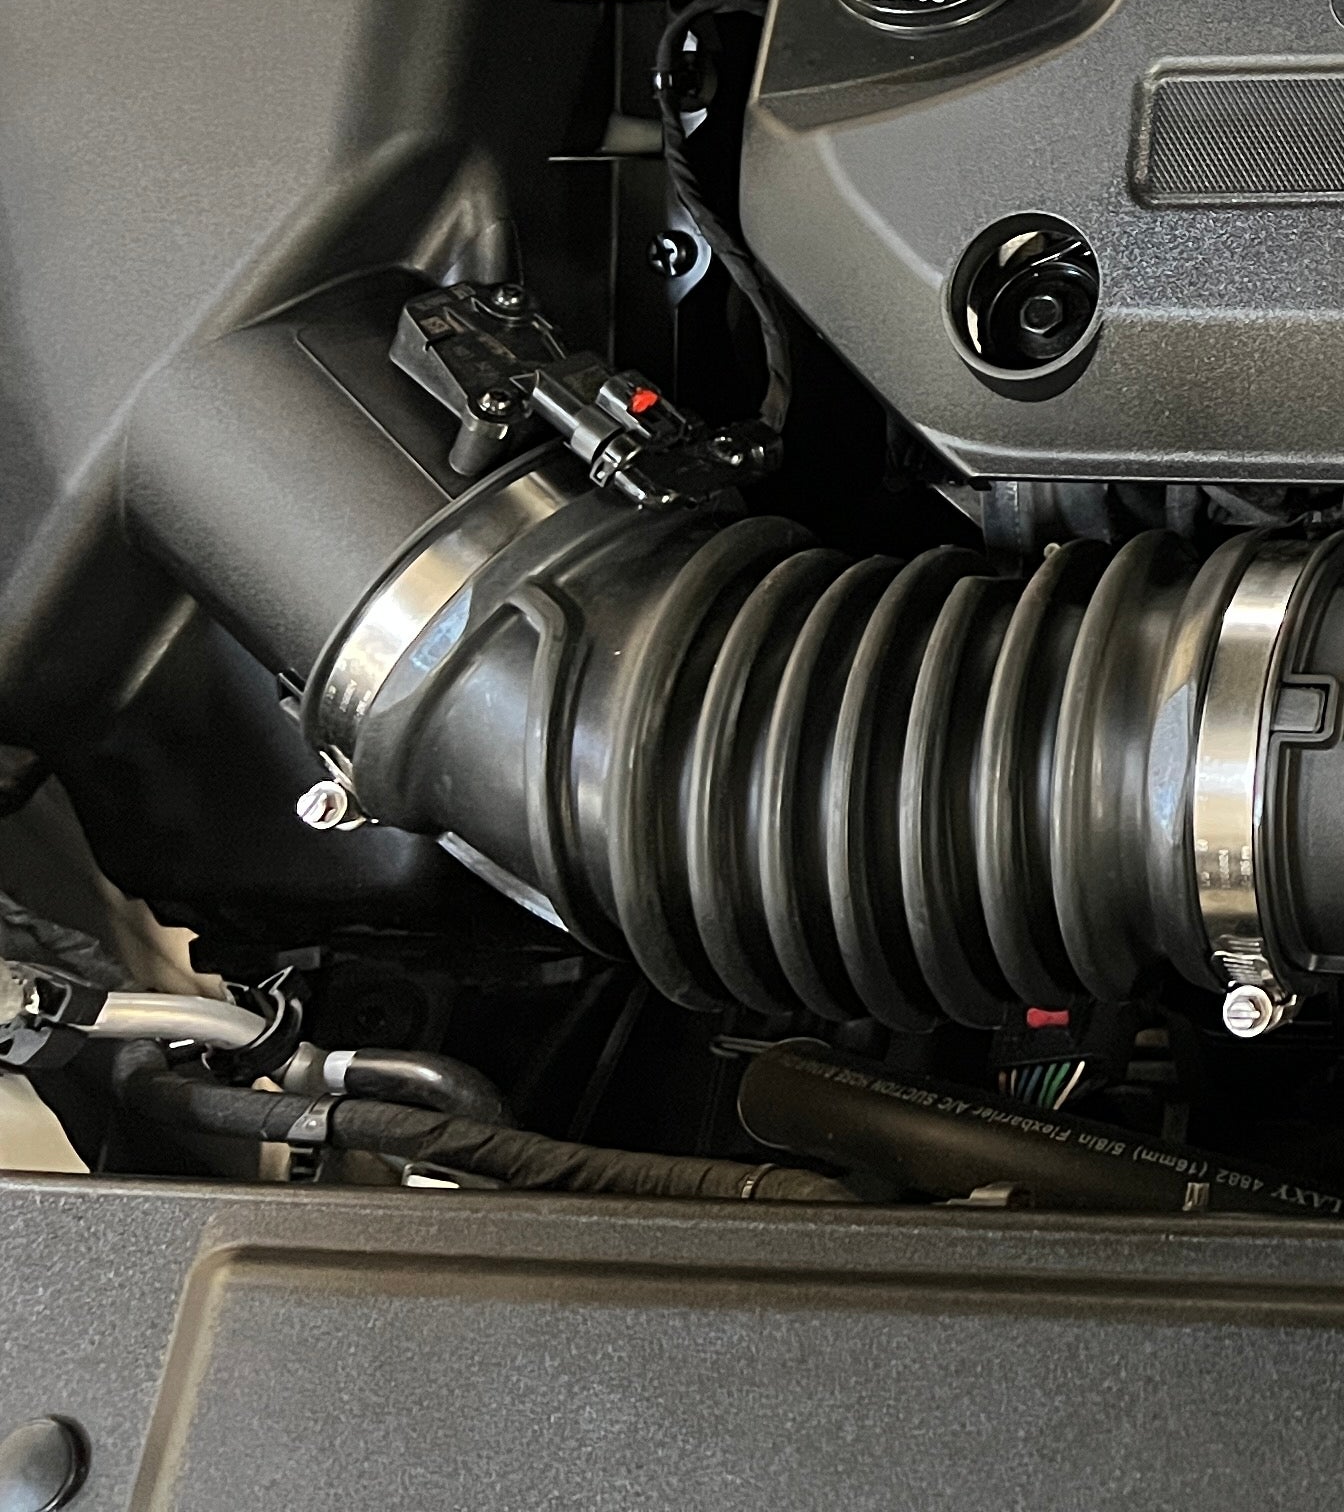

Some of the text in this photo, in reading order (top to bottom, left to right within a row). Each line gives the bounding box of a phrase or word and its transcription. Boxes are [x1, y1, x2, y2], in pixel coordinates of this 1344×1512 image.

[874, 1077, 938, 1111] SUCTION
[937, 1096, 972, 1118] A/C
[972, 1104, 1073, 1143] Flexbarrier
[1132, 1146, 1210, 1179] (16mm)
